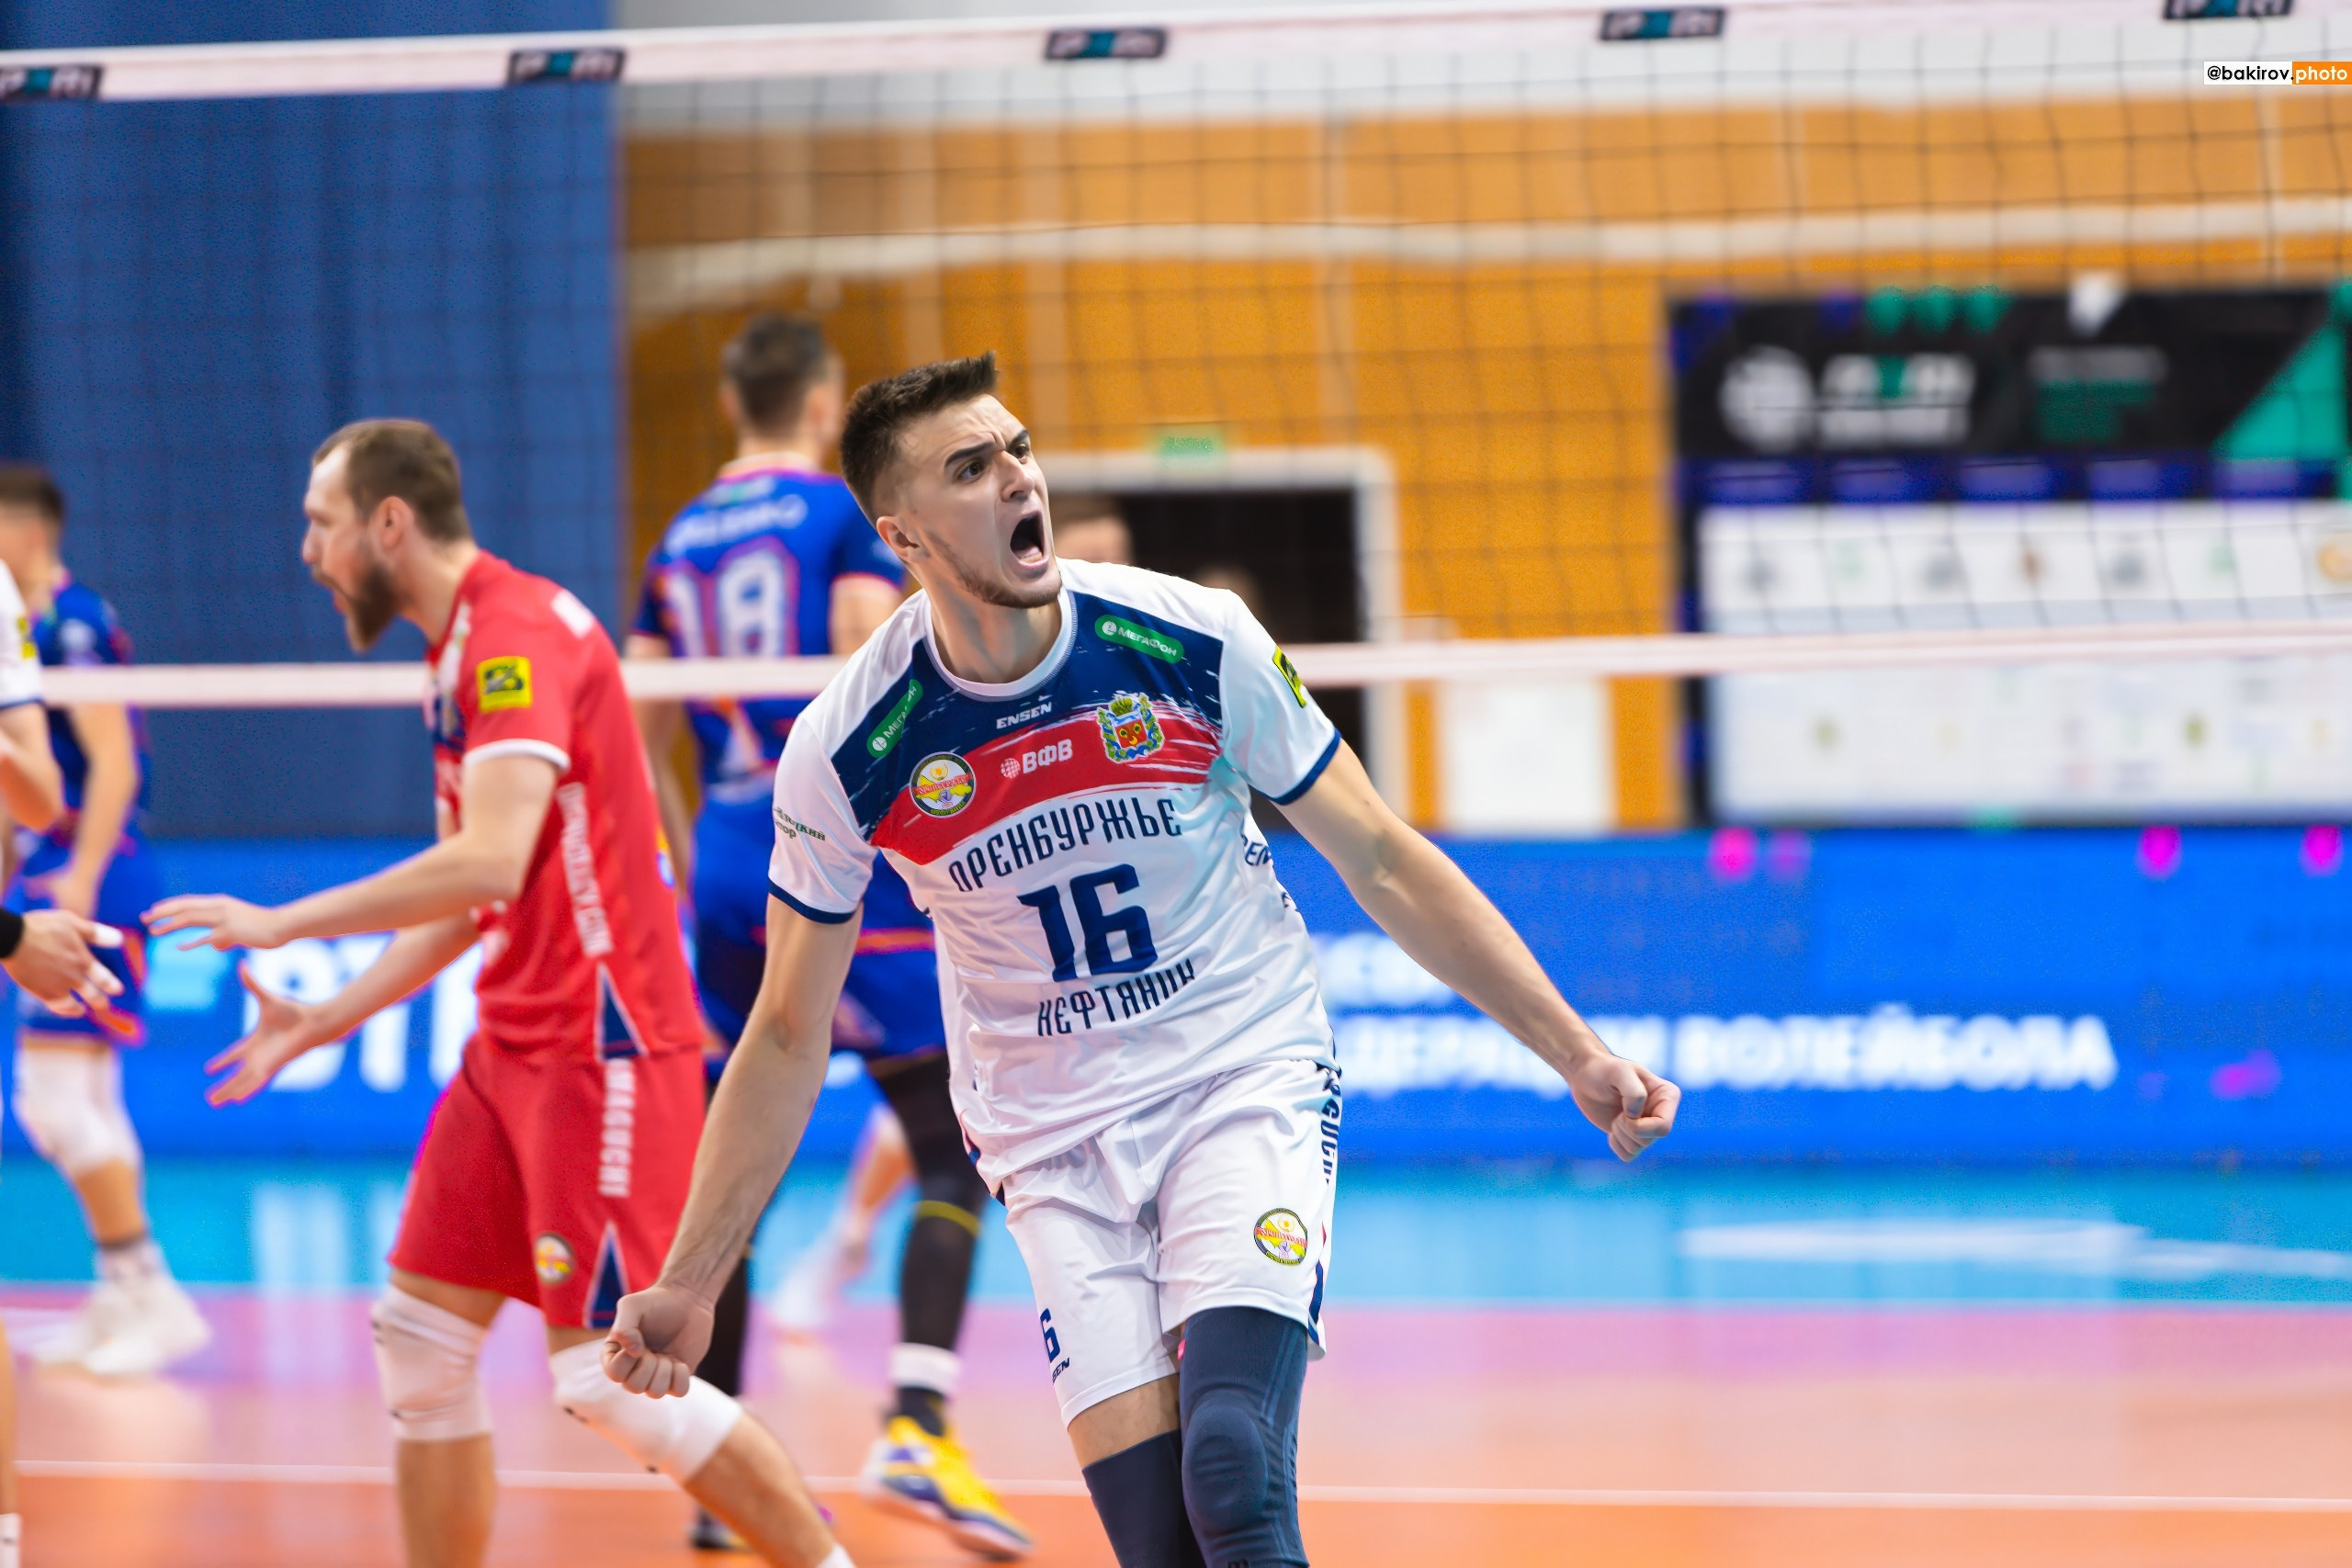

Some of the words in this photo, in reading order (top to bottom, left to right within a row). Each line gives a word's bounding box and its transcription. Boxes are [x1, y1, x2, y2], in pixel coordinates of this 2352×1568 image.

[662, 546, 786, 660] 18
[996, 701, 1052, 729] ENSEN
[1022, 739, 1073, 774] ВФВ
[948, 796, 1183, 893] ОРЕНБУРЖЬЕ
[1016, 863, 1159, 983] 16
[1037, 958, 1195, 1037] НЕФТЯНИК
[1676, 1003, 2116, 1089] ВОЛЕЙБОЛА
